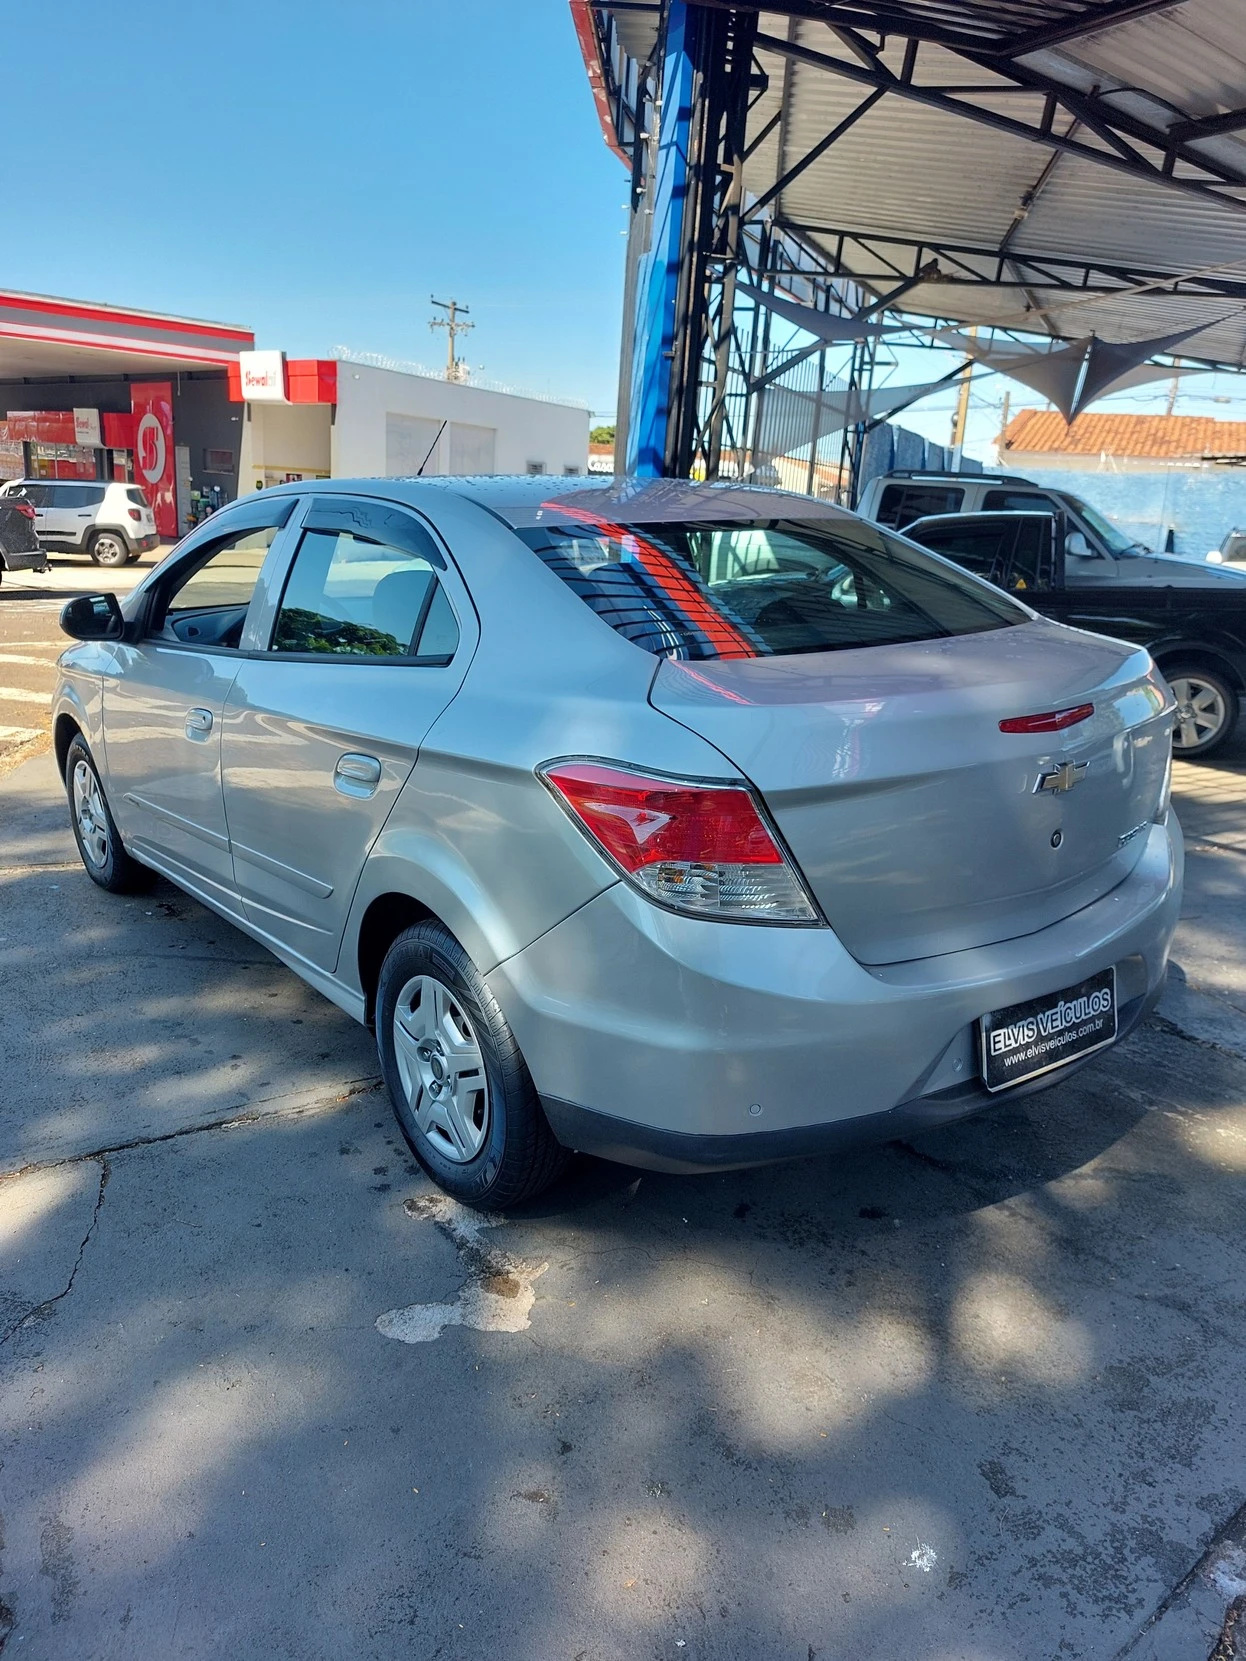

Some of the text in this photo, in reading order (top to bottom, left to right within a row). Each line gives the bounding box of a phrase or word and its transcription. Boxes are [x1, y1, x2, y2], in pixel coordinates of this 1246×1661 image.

[990, 988, 1112, 1056] ELVIS VEÍCULOS
[1004, 1018, 1103, 1067] www.elvisveiculos.com.br
